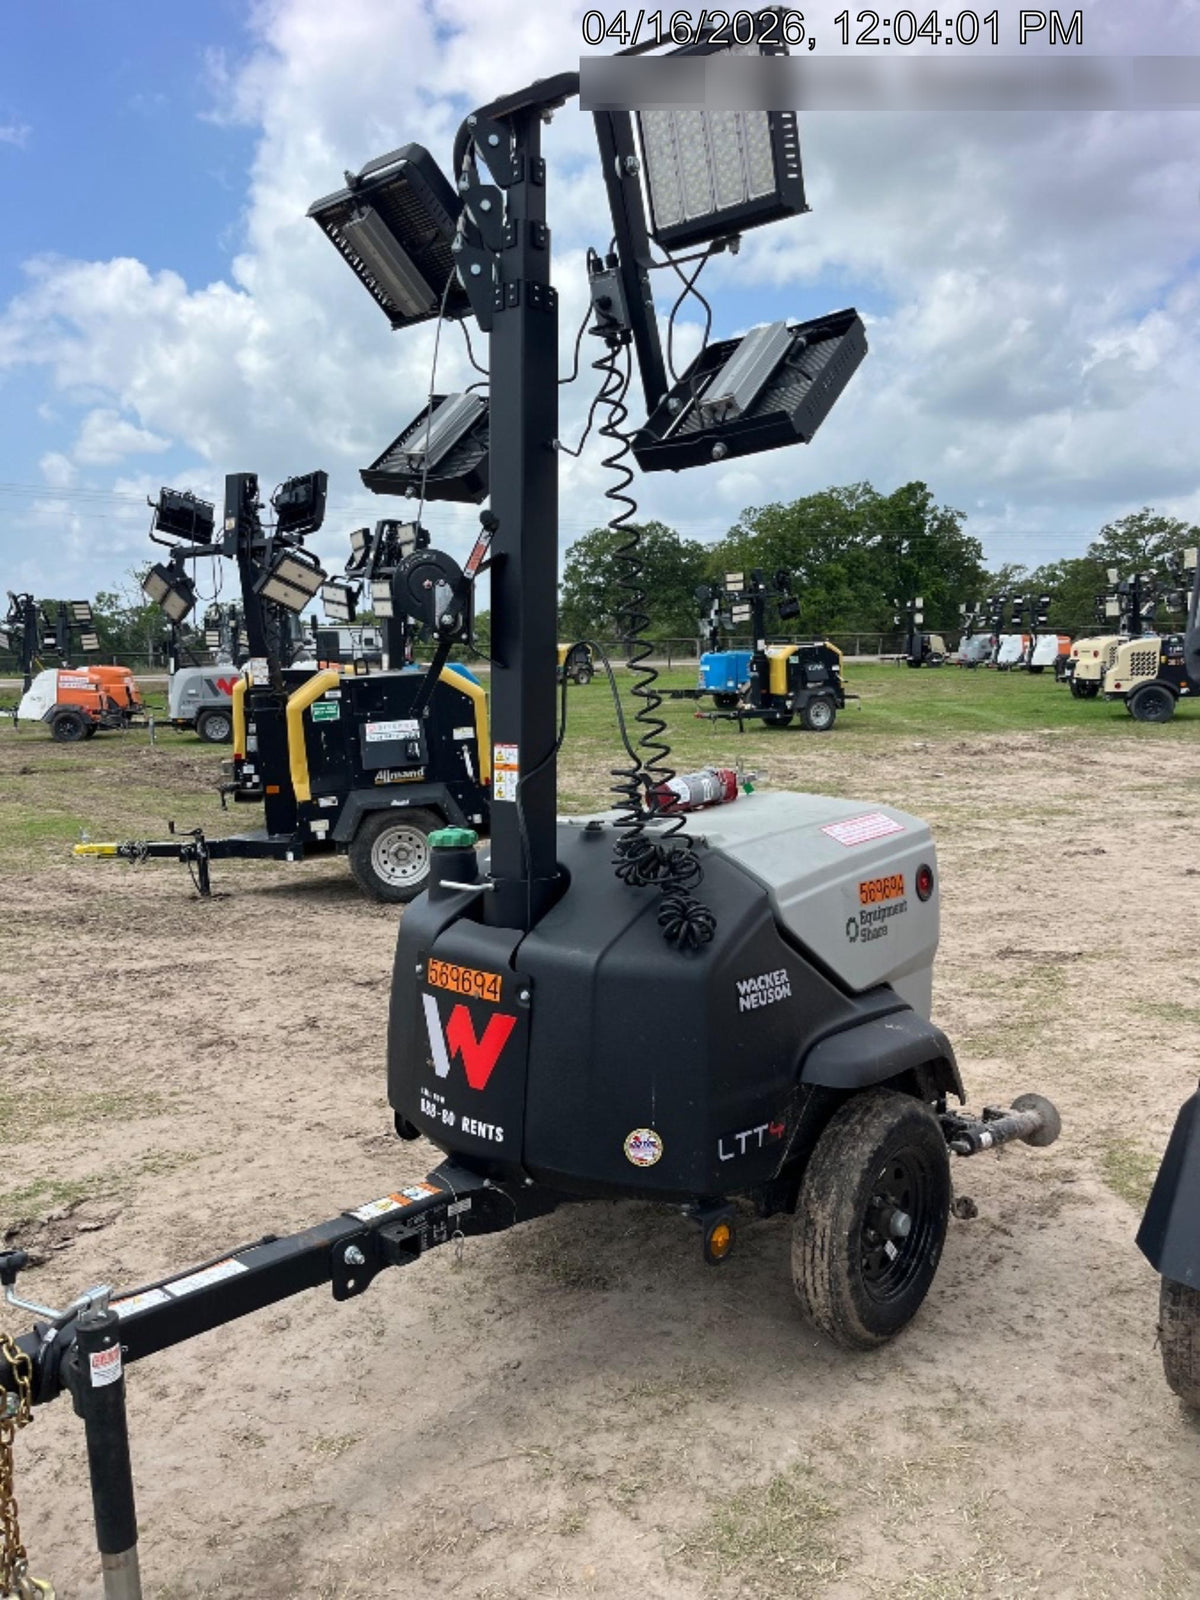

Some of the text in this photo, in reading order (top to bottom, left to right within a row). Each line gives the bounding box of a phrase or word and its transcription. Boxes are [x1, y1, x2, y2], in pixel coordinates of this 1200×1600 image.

[374, 766, 425, 784] Allmand
[859, 900, 908, 926] Equipment
[860, 925, 889, 943] Share
[429, 961, 499, 1000] 569694
[735, 968, 790, 996] WACKER
[739, 982, 792, 1012] NEUSON
[461, 1115, 504, 1143] RENTS
